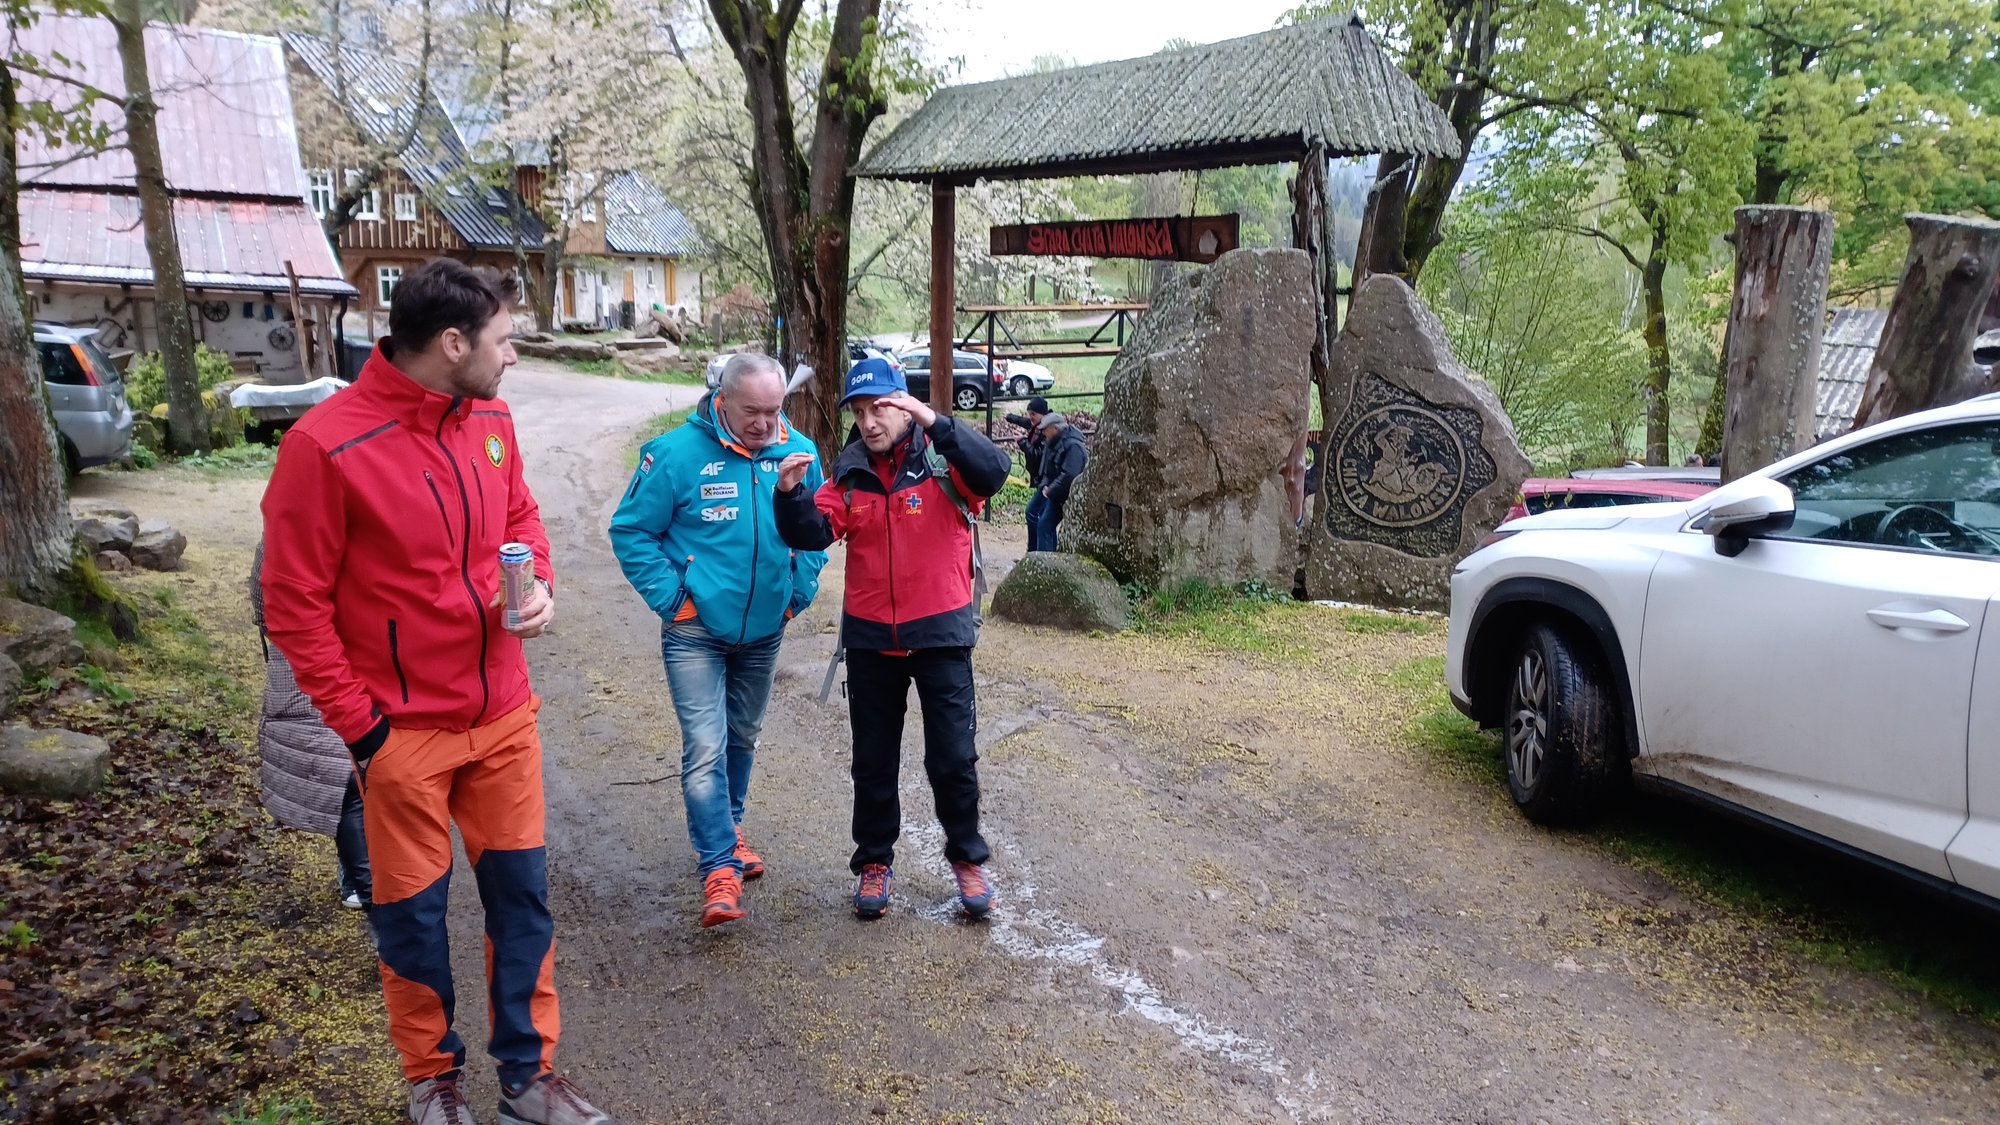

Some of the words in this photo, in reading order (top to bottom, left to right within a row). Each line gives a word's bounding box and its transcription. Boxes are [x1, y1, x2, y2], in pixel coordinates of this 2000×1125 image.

[1027, 224, 1070, 254] STARA
[1072, 223, 1106, 255] CHATA
[851, 372, 873, 386] GOPR
[1342, 458, 1369, 510] CHATA
[1372, 473, 1458, 521] WALOŃSKA
